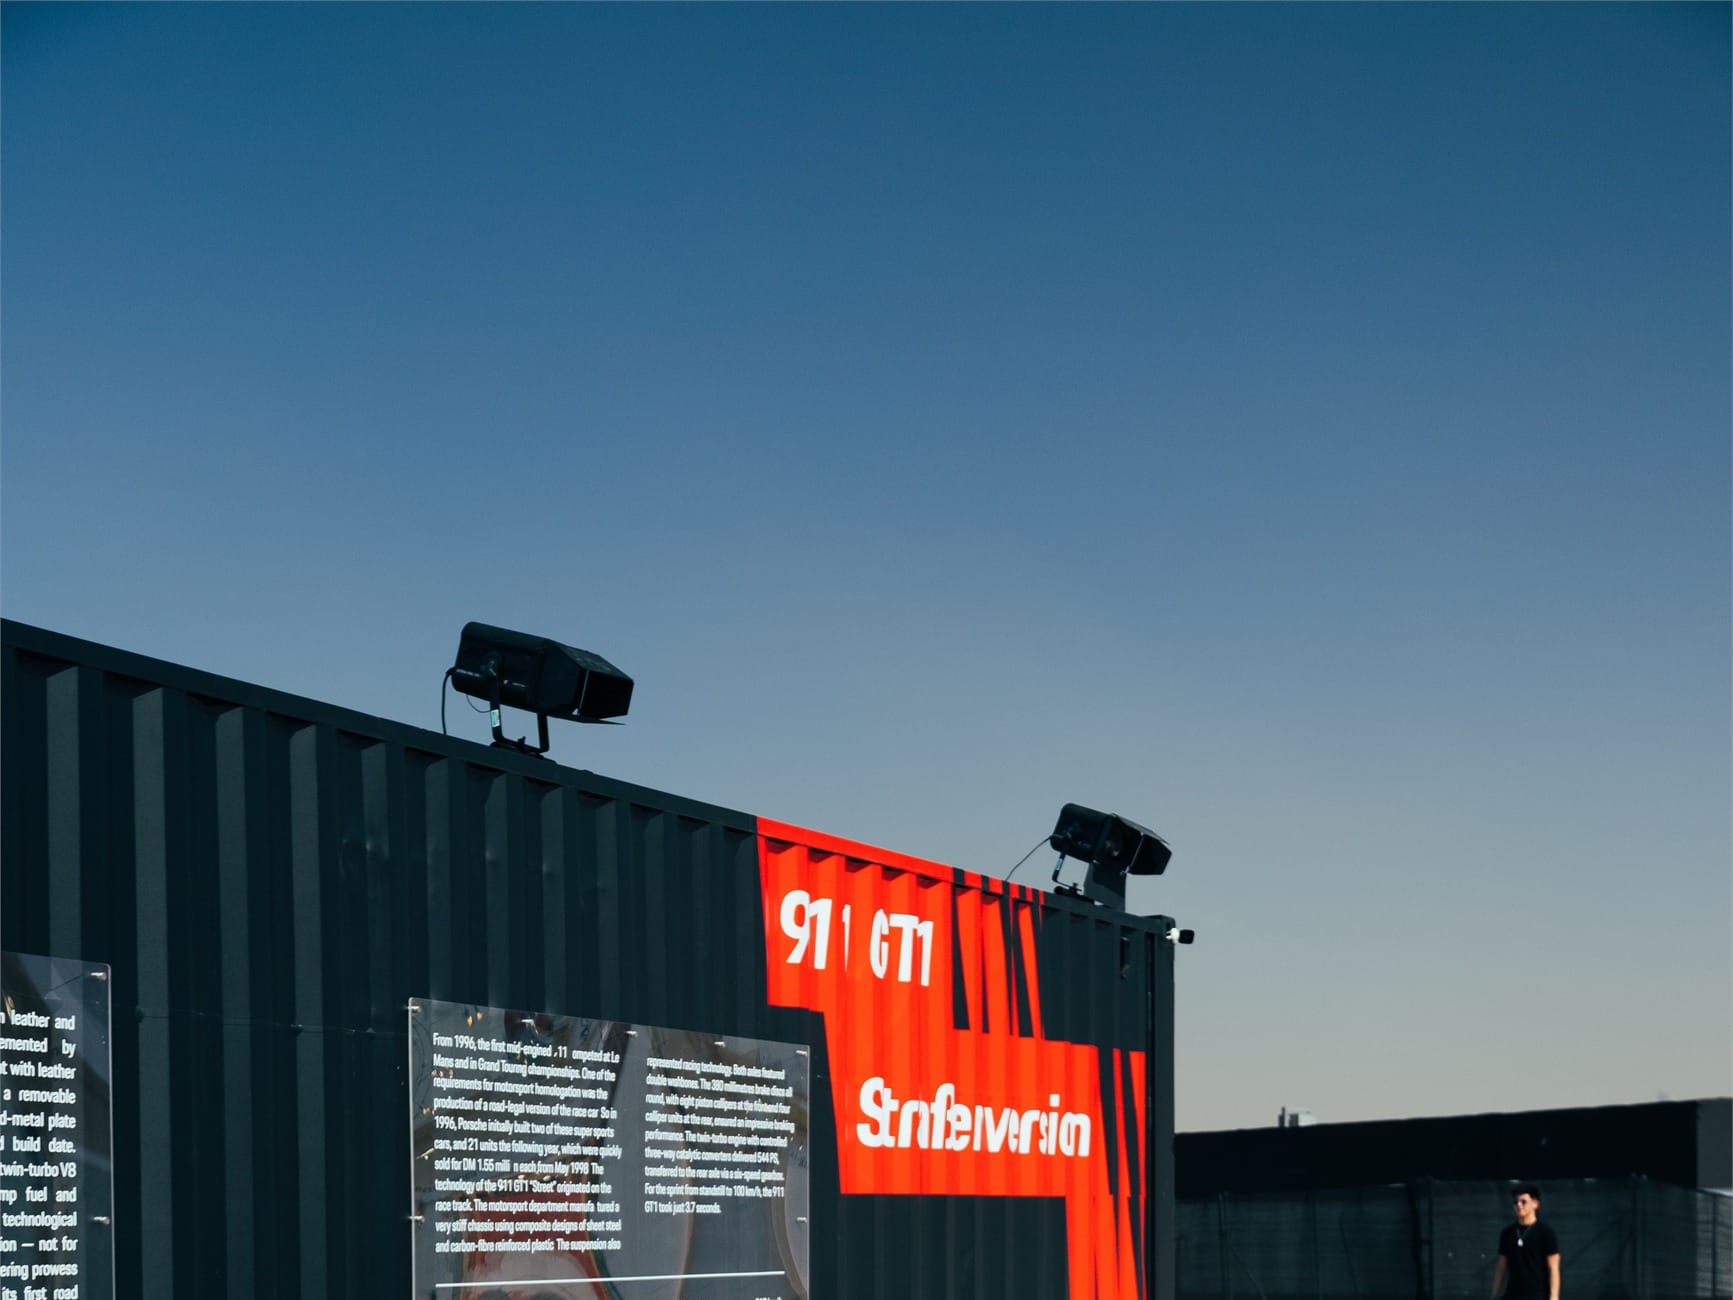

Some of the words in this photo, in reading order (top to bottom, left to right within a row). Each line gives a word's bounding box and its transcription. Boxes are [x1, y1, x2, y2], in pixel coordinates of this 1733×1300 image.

[780, 890, 851, 973] 911
[869, 909, 934, 987] GT1
[11, 1009, 50, 1028] leather
[54, 1015, 75, 1030] and
[62, 1039, 77, 1058] by
[10, 1060, 36, 1077] with
[37, 1062, 76, 1079] leather
[3, 1089, 12, 1101] a
[19, 1088, 76, 1104] removable
[48, 1112, 76, 1131] plate
[12, 1136, 41, 1152] build
[48, 1137, 76, 1153] date.
[0, 1161, 59, 1177] twin-turbo
[59, 1162, 77, 1178] V8
[495, 1159, 519, 1172] millin
[25, 1186, 47, 1202] fuel
[55, 1187, 77, 1202] and
[2, 1211, 78, 1230] technological
[39, 1237, 58, 1251] not
[61, 1235, 78, 1251] for
[31, 1263, 78, 1280] prowess
[53, 1284, 79, 1300] road
